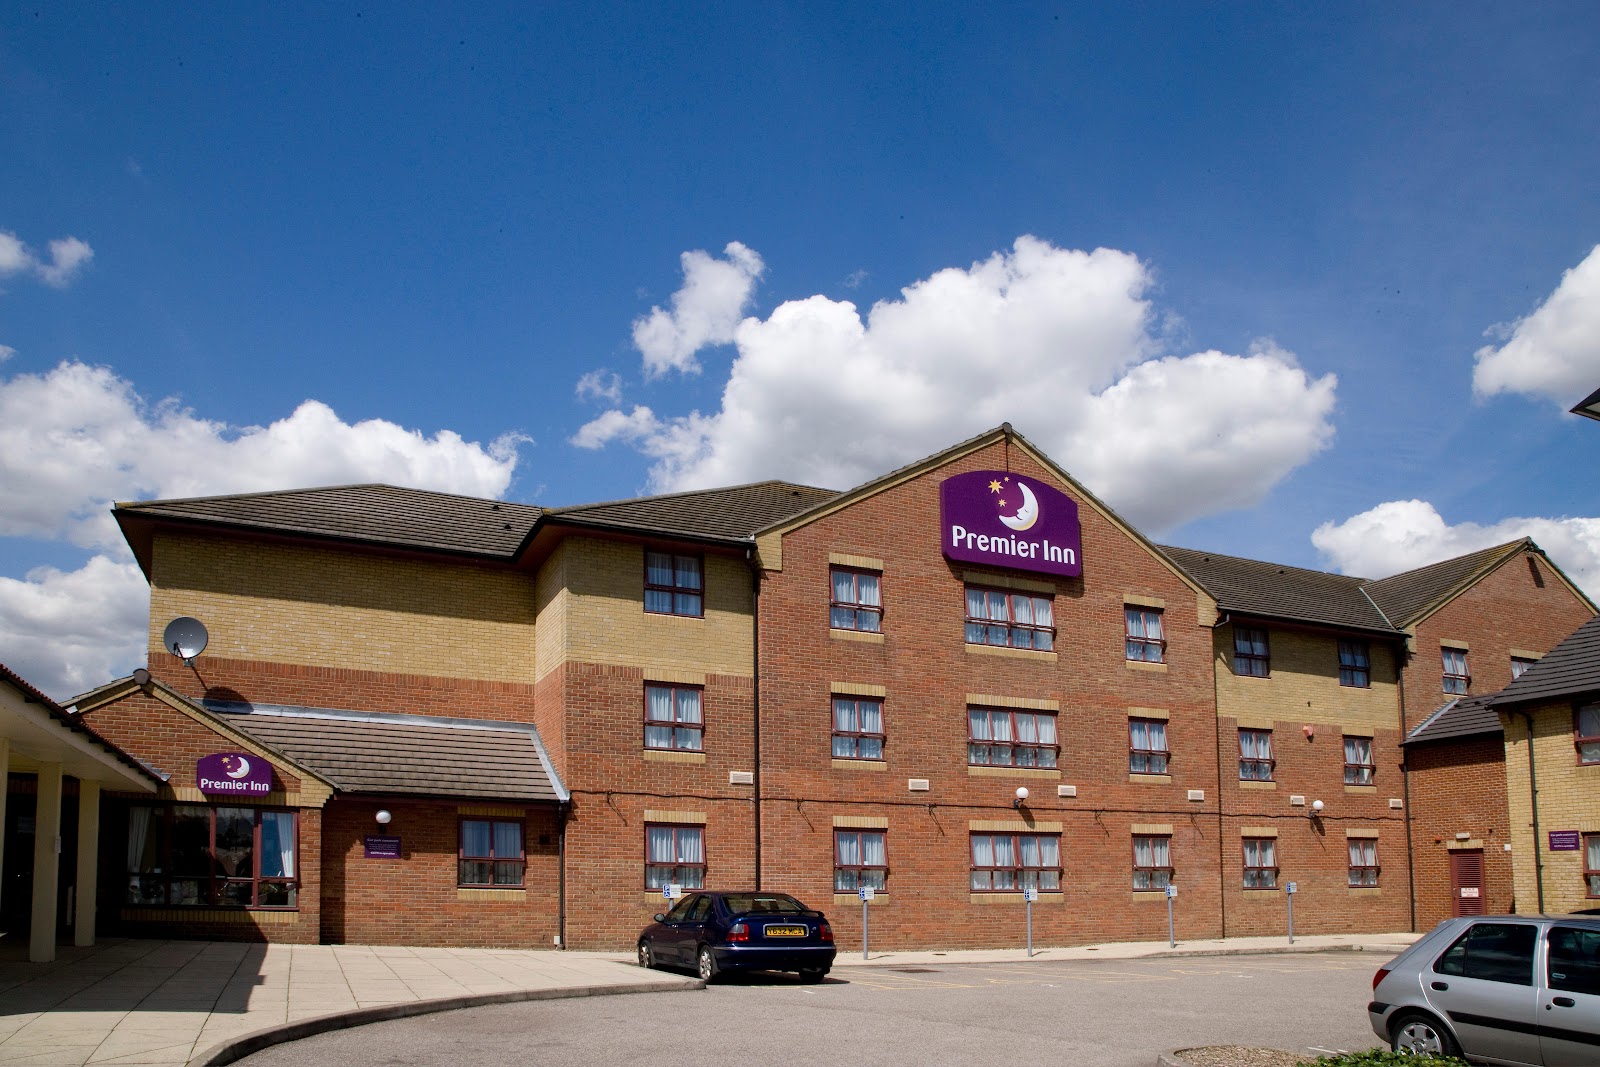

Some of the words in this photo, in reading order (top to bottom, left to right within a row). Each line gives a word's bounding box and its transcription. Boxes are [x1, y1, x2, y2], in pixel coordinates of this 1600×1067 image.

[952, 525, 1039, 559] Premier
[1043, 539, 1075, 565] Inn
[200, 778, 249, 790] Premier
[250, 780, 269, 791] Inn
[767, 927, 787, 935] Y632
